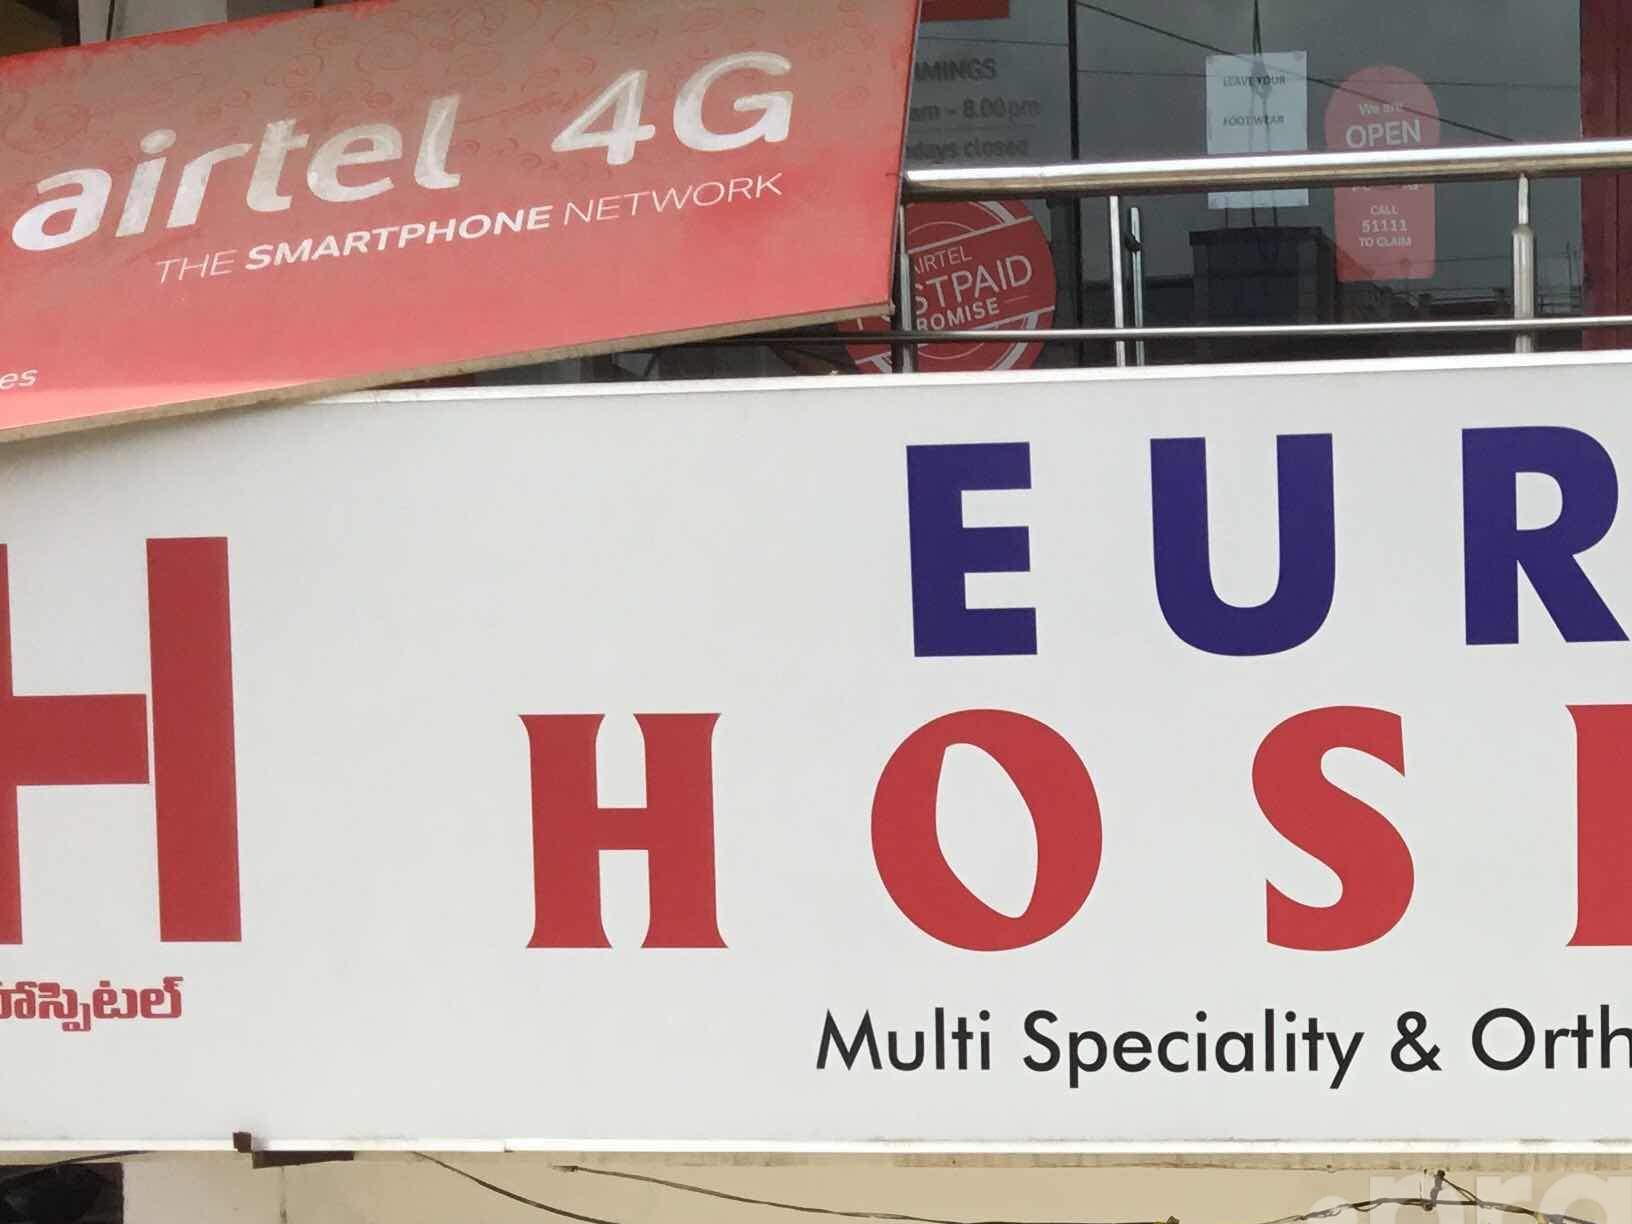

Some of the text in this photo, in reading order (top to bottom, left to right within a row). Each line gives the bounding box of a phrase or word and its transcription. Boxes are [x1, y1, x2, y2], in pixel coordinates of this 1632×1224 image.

[12, 51, 793, 252] airtel 4G
[1345, 119, 1422, 149] OPEN
[157, 173, 783, 284] THE SMARTPHONE NETWORK
[1370, 203, 1400, 216] CALL
[1359, 235, 1413, 248] TO CLAIM
[816, 1008, 992, 1073] Multi
[1024, 1009, 1365, 1091] Speciality
[1391, 1012, 1443, 1074] &
